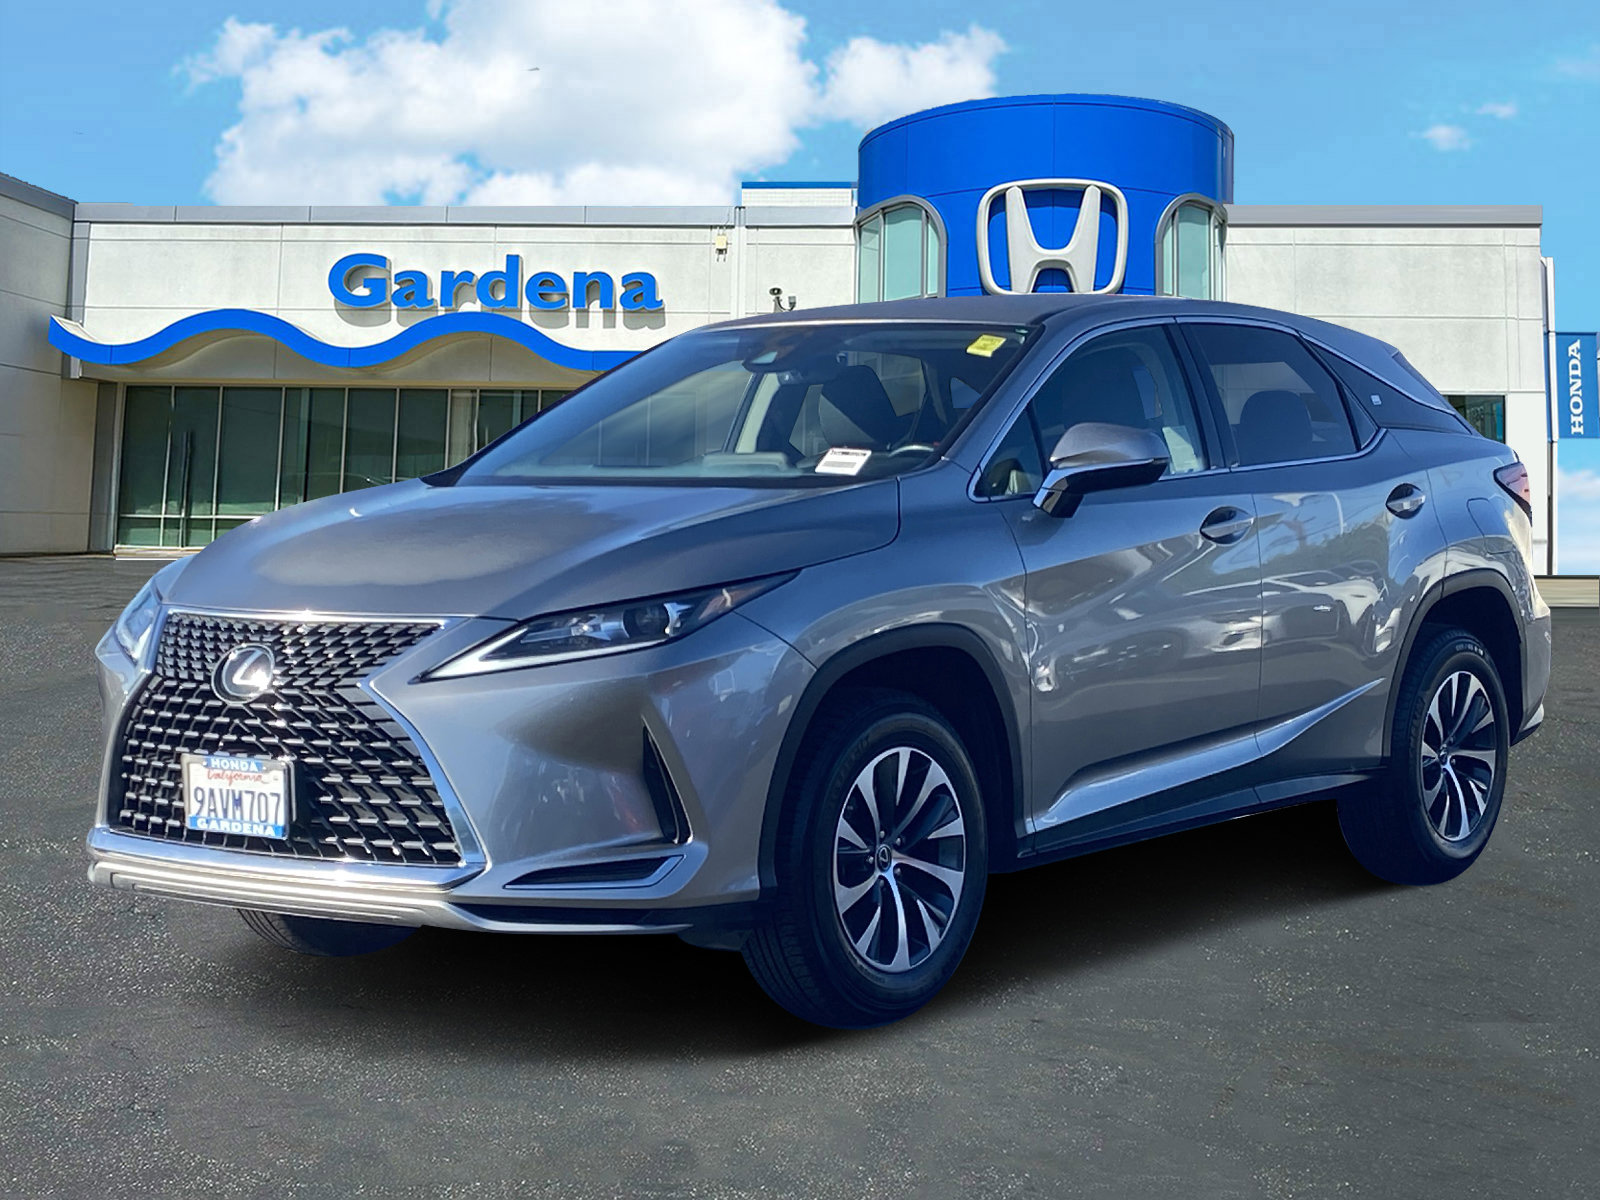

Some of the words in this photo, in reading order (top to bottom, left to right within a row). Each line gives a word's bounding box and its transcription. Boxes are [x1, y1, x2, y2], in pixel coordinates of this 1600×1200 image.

[328, 252, 664, 310] Gardena
[1568, 339, 1584, 435] HONDA
[210, 757, 259, 772] HONDA
[193, 786, 281, 825] 9AVM707
[196, 817, 277, 837] GARDENA
